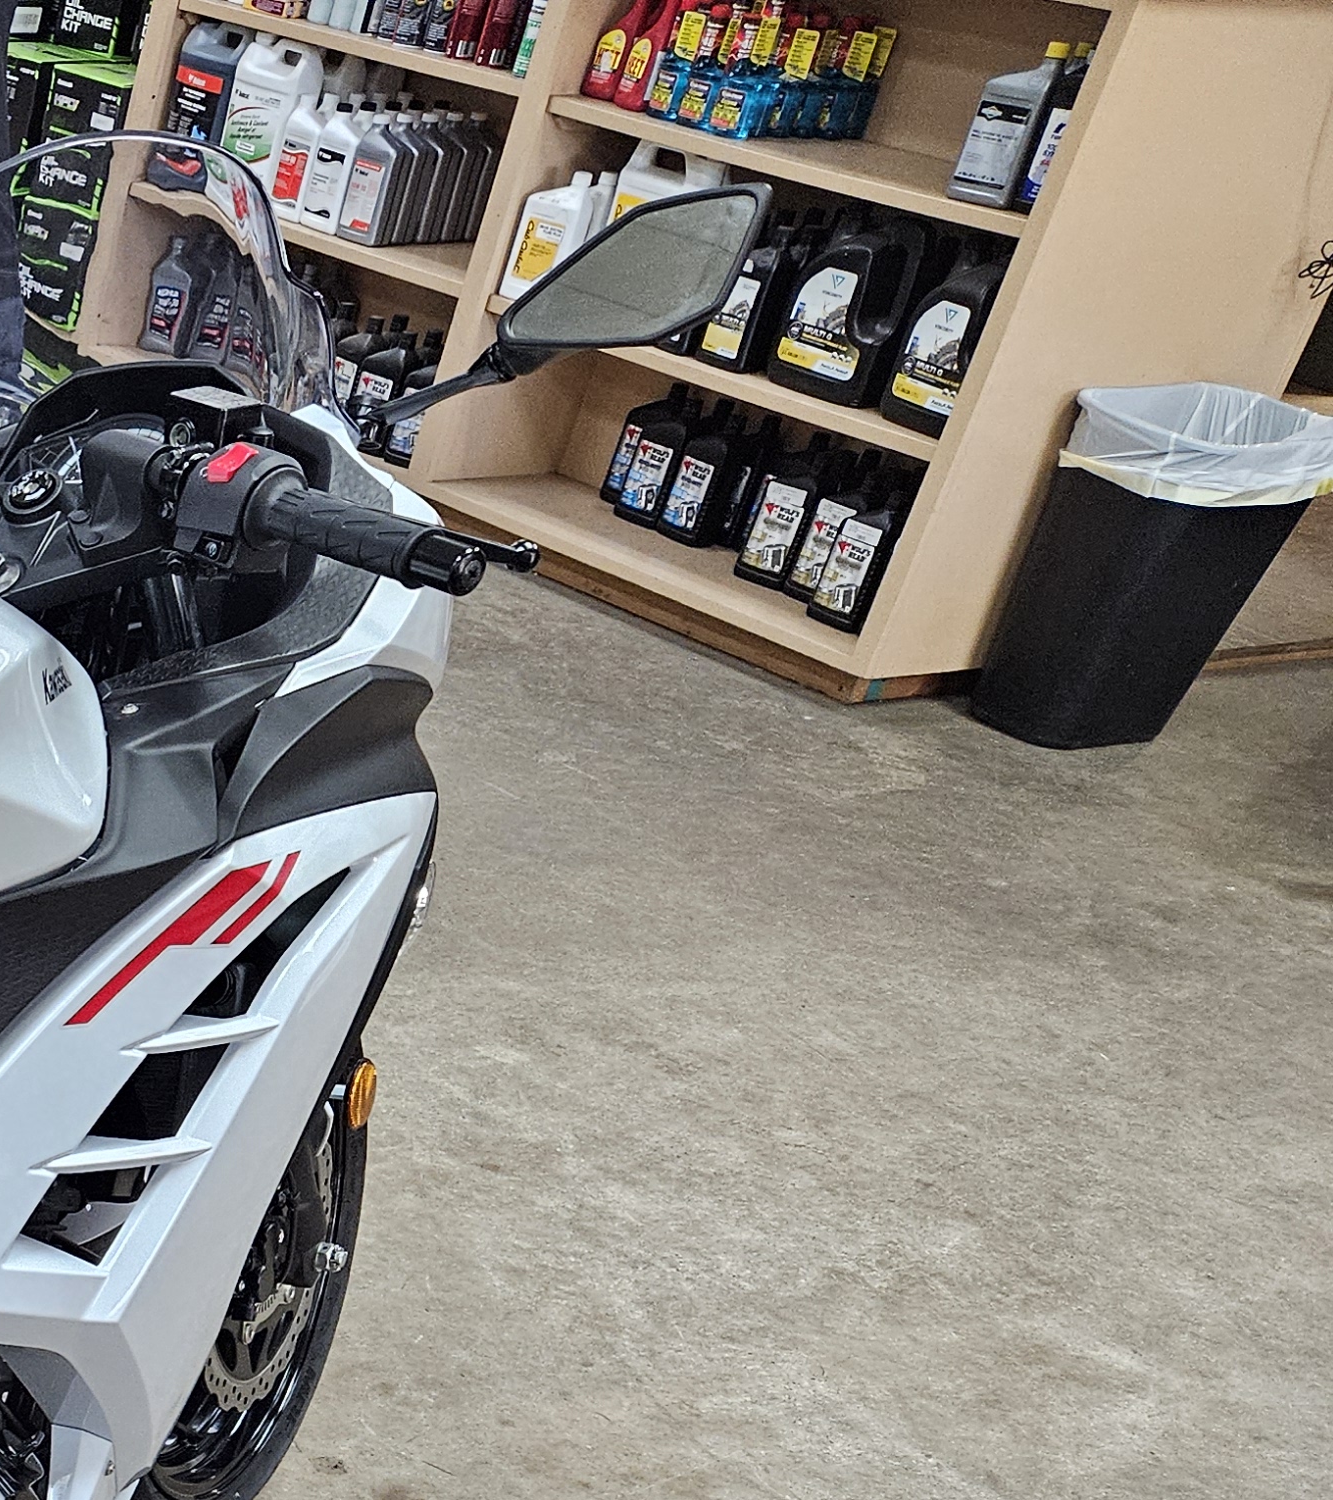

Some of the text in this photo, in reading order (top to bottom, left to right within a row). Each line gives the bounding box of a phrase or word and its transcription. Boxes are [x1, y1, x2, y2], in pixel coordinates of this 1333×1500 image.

[60, 18, 81, 33] KIT
[63, 7, 113, 30] CHANGE
[39, 164, 87, 187] CHANGE
